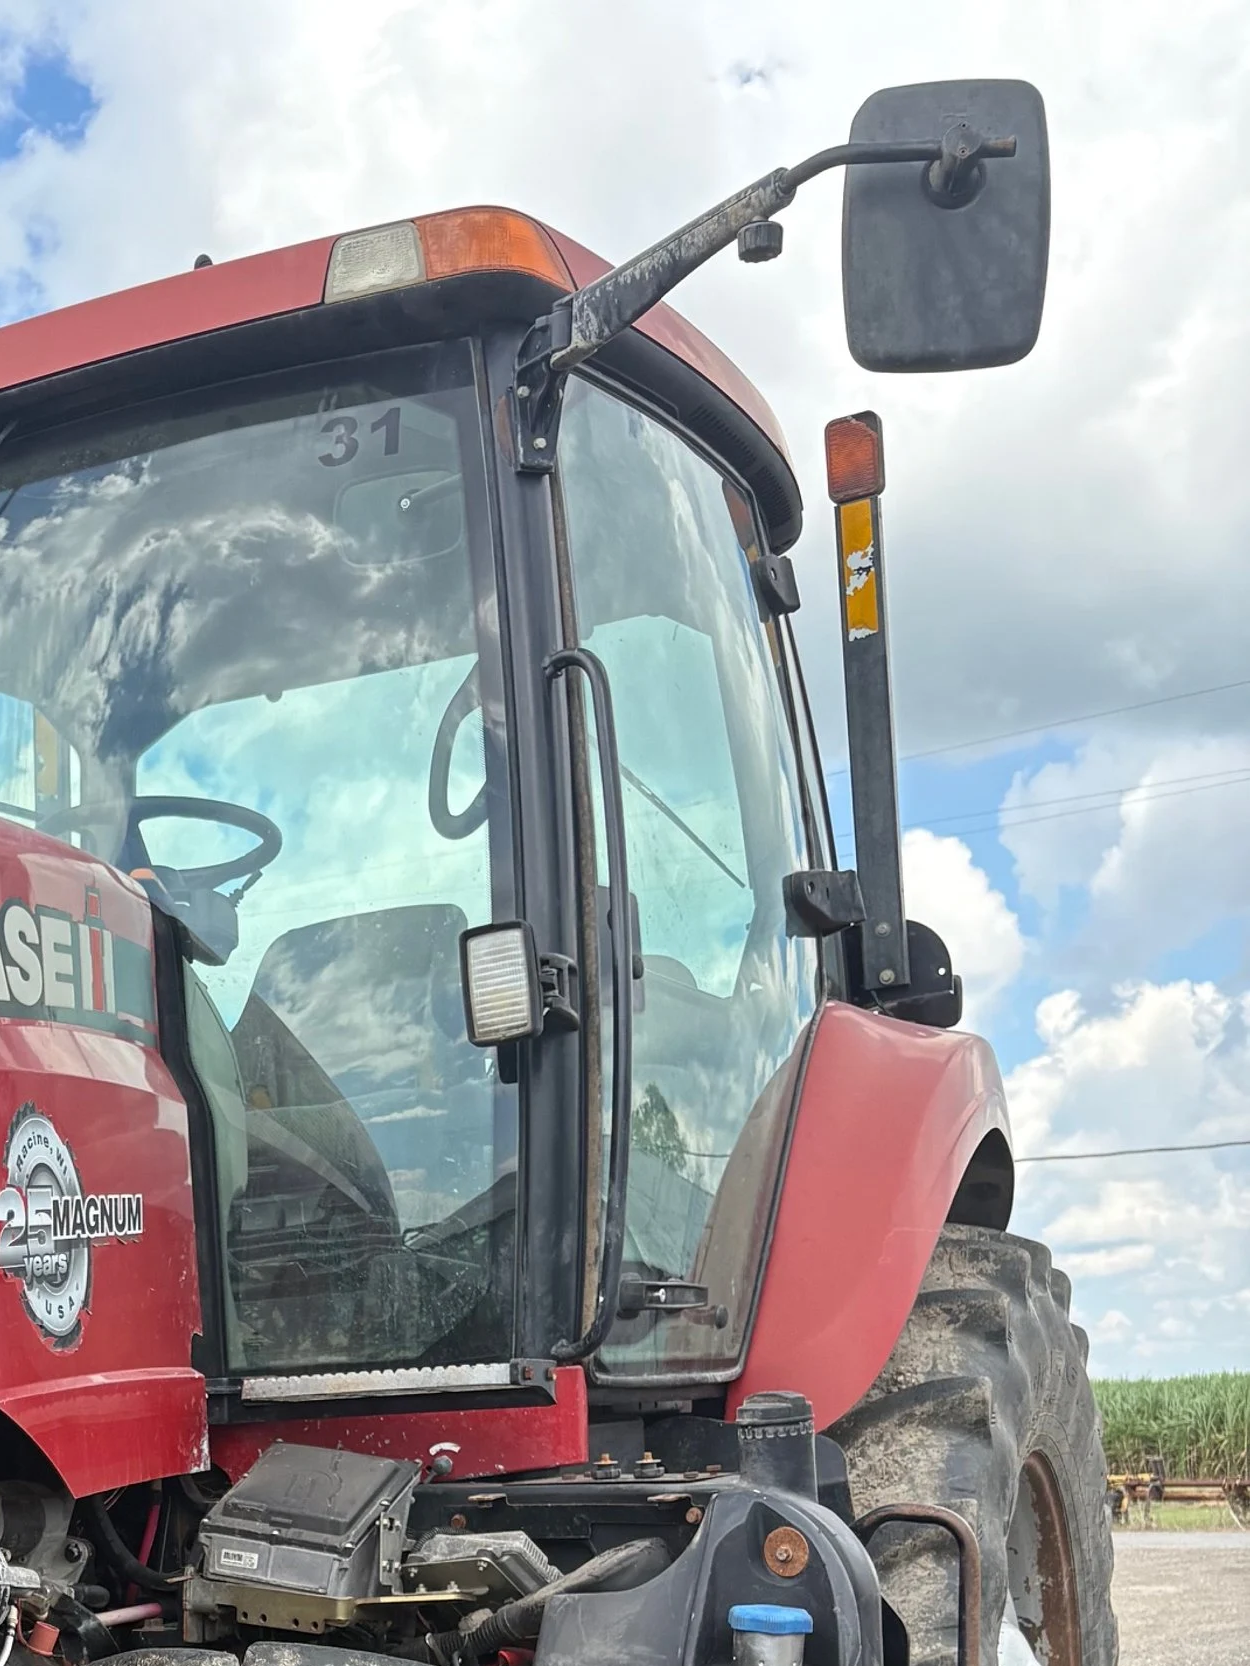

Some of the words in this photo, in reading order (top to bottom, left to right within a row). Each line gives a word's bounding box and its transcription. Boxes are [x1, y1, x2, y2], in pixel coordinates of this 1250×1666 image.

[317, 406, 402, 468] 31
[50, 1194, 145, 1241] MAGNUM
[22, 1252, 69, 1287] years
